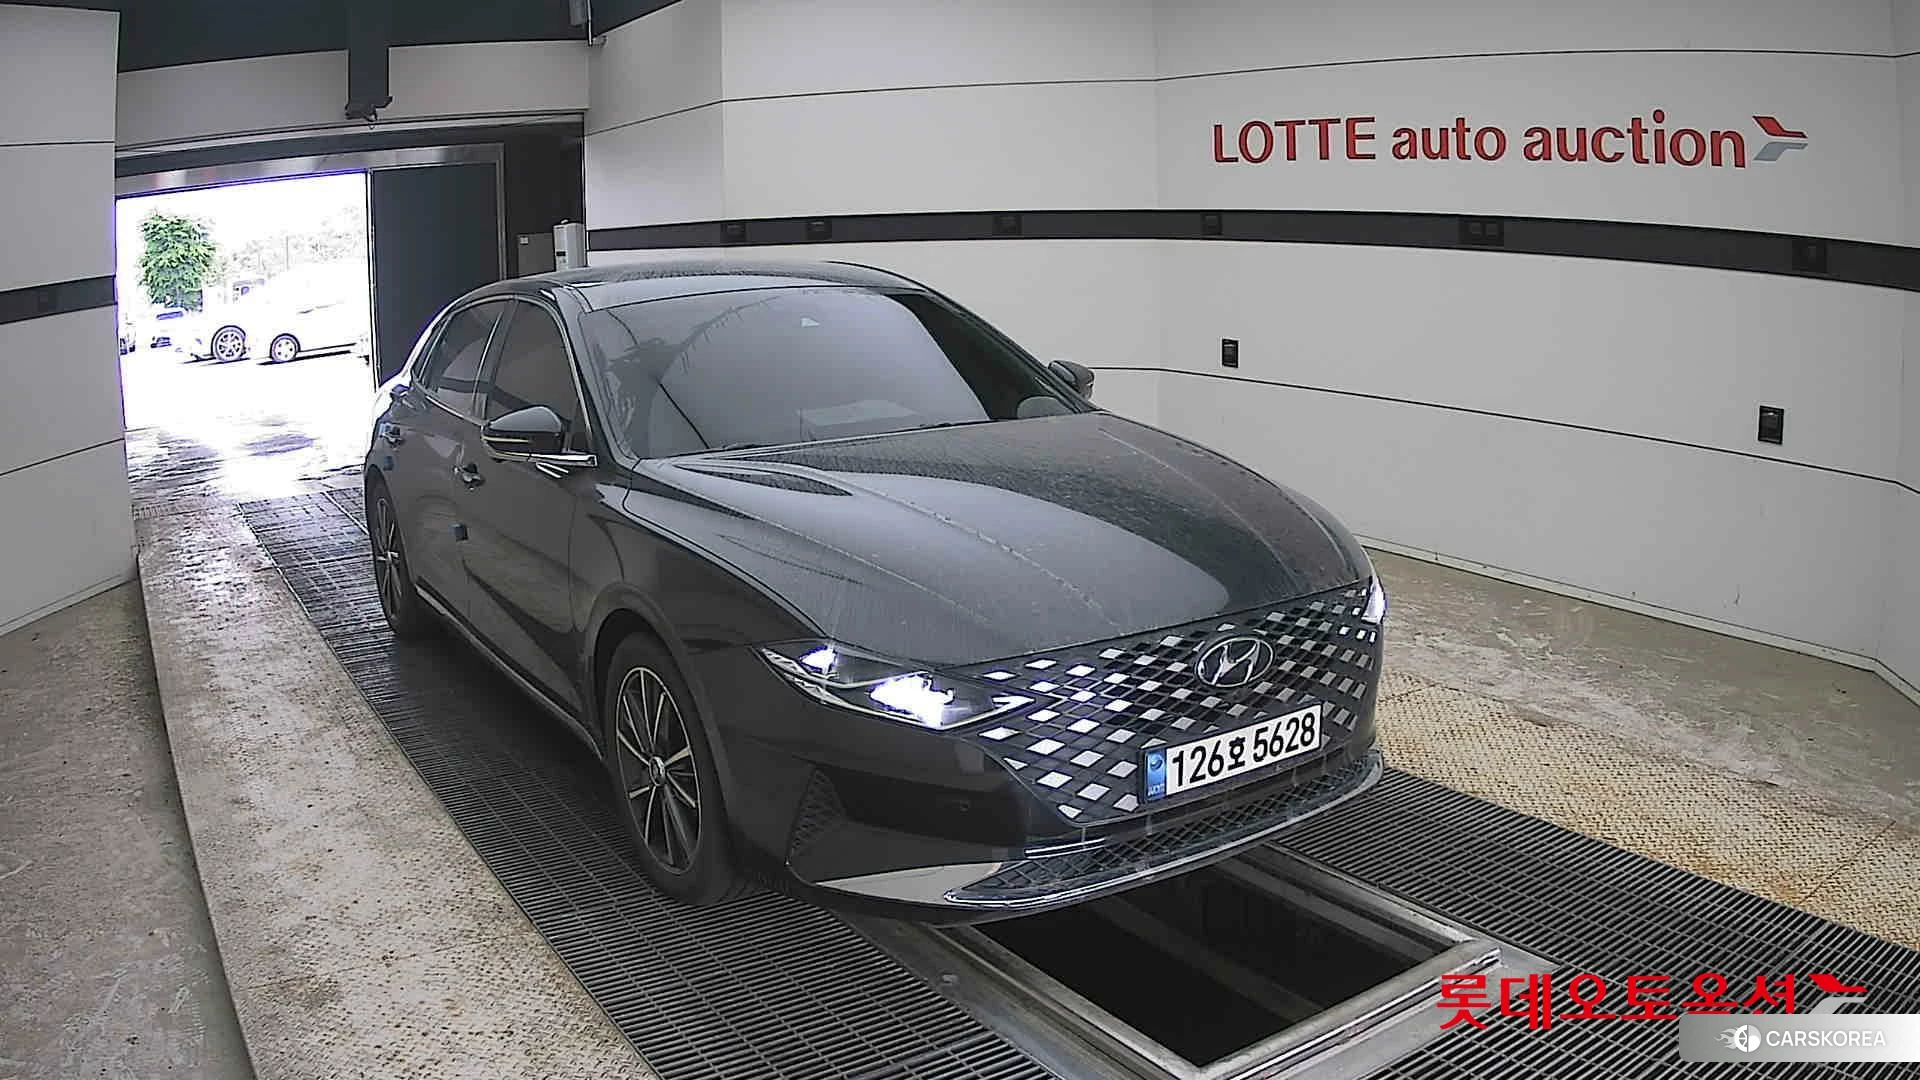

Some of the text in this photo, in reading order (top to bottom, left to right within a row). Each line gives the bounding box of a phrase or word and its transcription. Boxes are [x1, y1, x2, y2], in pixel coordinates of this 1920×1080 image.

[1213, 109, 1746, 168] LOTTE auto auction
[1252, 712, 1316, 763] 5628
